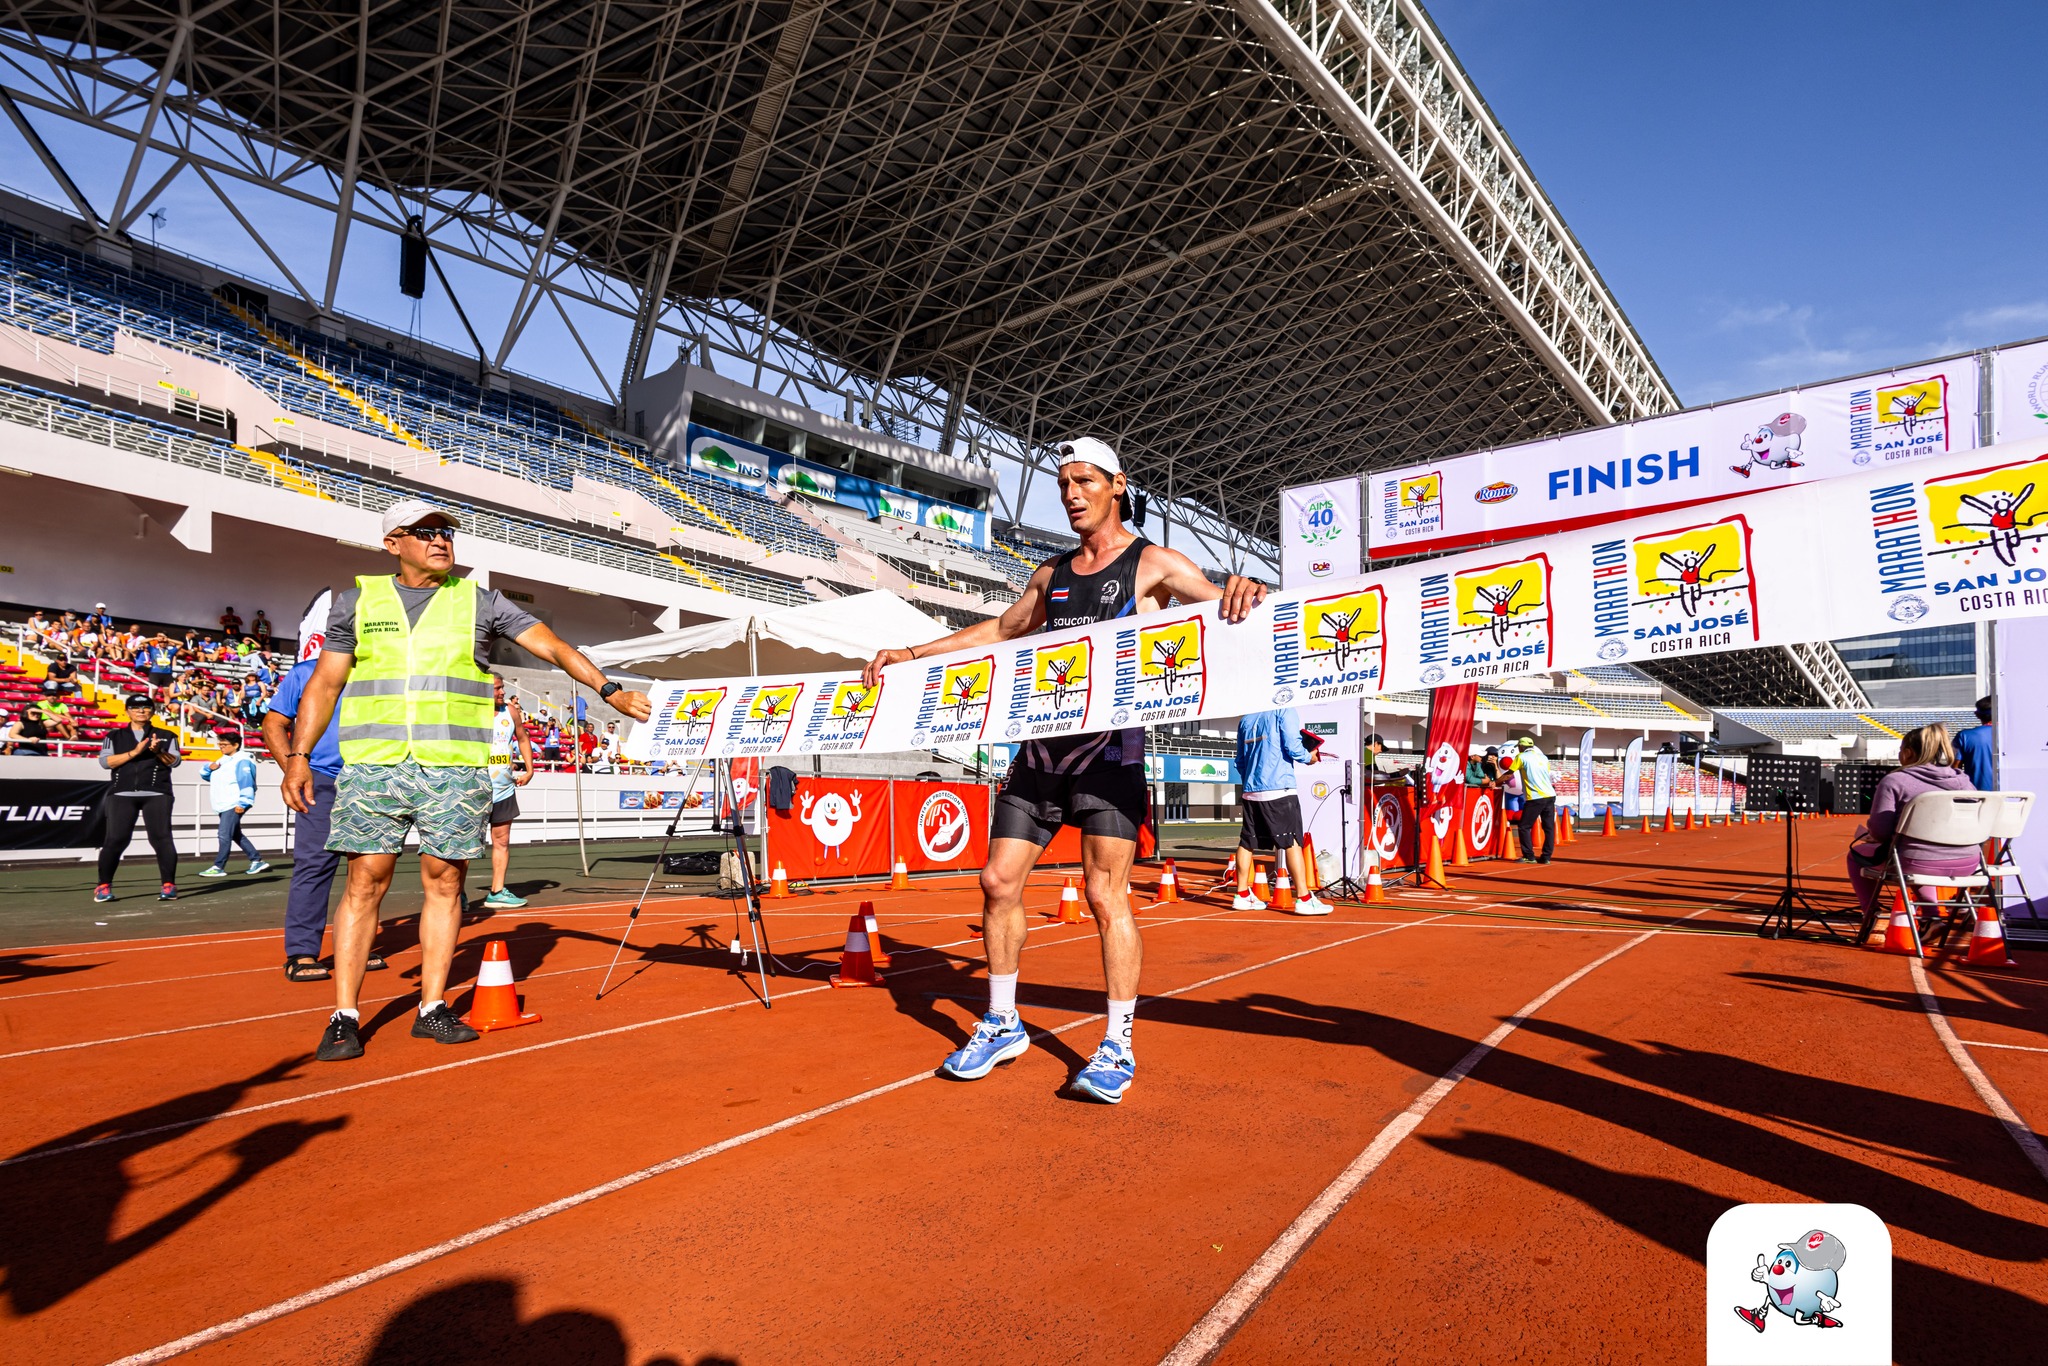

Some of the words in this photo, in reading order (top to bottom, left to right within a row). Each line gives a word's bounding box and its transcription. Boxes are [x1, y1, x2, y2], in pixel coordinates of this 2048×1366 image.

[2028, 382, 2042, 412] WORLD
[1850, 388, 1872, 450] MARATHON
[1874, 440, 1904, 451] SAN
[1908, 432, 1943, 446] JOSÉ
[1885, 449, 1910, 460] COSTA
[1914, 446, 1933, 457] RICA
[738, 463, 762, 478] INS
[1549, 446, 1699, 500] FINISH
[1479, 485, 1516, 500] Roma
[1308, 500, 1334, 512] AIMS
[1384, 480, 1398, 526] MARATHON
[892, 507, 912, 520] INS
[1308, 508, 1334, 528] 40
[1399, 520, 1417, 529] SAN
[1419, 515, 1440, 526] JOSÉ
[1405, 527, 1421, 536] COSTA
[1422, 525, 1434, 534] RICA
[1870, 482, 1927, 594] MARATHON
[1312, 562, 1330, 571] Dole
[1592, 538, 1629, 638] MARATHON
[1934, 573, 1998, 596] SAN
[1960, 592, 2016, 612] COSTA
[1054, 615, 1096, 626] saucony
[1419, 573, 1450, 665] MARATHON
[1634, 622, 1682, 640] SAN
[1688, 608, 1750, 635] JOSÉ
[1273, 601, 1300, 686] MARATHON
[1651, 638, 1694, 654] COSTA
[1700, 632, 1731, 648] RICA
[1451, 651, 1492, 666] SAN
[1497, 640, 1546, 660] JOSÉ
[1113, 628, 1136, 708] MARATHON
[1300, 676, 1334, 688] SAN
[1337, 666, 1379, 684] JOSÉ
[1464, 664, 1500, 679] COSTA
[1503, 660, 1530, 674] RICA
[1008, 648, 1034, 720] MARATHON
[1308, 687, 1338, 700] COSTA
[1341, 684, 1364, 696] RICA
[914, 665, 944, 730] MARATHON
[1134, 698, 1163, 710] SAN
[1165, 692, 1200, 707] JOSÉ
[652, 689, 686, 741] MARATHON
[726, 686, 760, 740] MARATHON
[804, 681, 838, 738] MARATHON
[1026, 713, 1051, 723] SAN
[1054, 705, 1084, 720] JOSÉ
[1140, 710, 1166, 722] COSTA
[1168, 708, 1188, 718] RICA
[930, 724, 954, 734] SAN
[955, 718, 982, 731] JOSÉ
[1032, 724, 1054, 734] COSTA
[1055, 722, 1072, 732] RICA
[664, 738, 682, 746] SAN
[684, 736, 706, 745] JOSÉ
[739, 736, 756, 744] SAN
[758, 734, 782, 744] JOSÉ
[818, 734, 838, 742] SAN
[840, 730, 864, 740] JOSÉ
[934, 734, 954, 744] COSTA
[955, 732, 971, 742] RICA
[668, 747, 682, 756] COSTA
[683, 747, 696, 756] RICA
[741, 746, 757, 754] COSTA
[758, 746, 772, 754] RICA
[820, 742, 837, 751] COSTA
[838, 741, 853, 750] RICA
[490, 756, 507, 764] 893
[926, 798, 932, 806] DE
[926, 803, 950, 826] JPS
